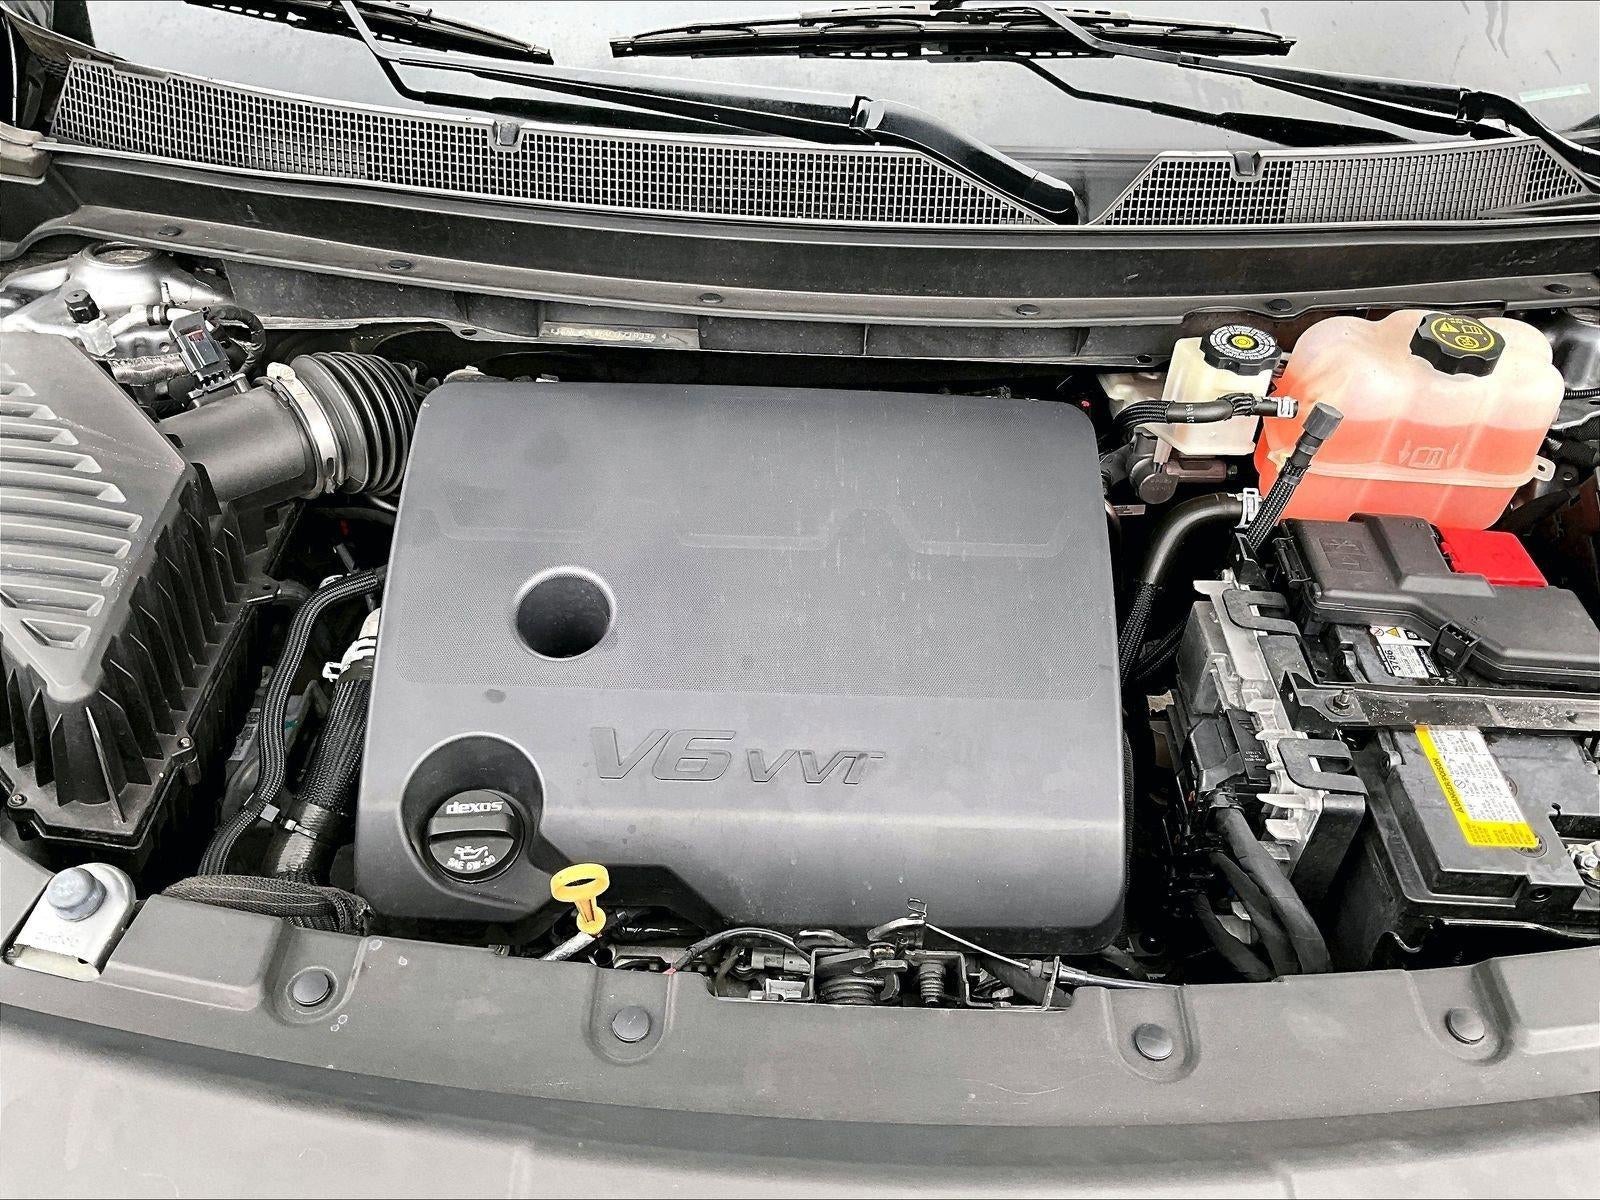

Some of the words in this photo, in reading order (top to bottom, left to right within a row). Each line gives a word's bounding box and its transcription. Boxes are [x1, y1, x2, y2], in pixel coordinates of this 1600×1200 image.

[591, 727, 736, 781] V6
[746, 749, 885, 784] VVT
[446, 801, 504, 815] dexos
[447, 857, 465, 870] SAE
